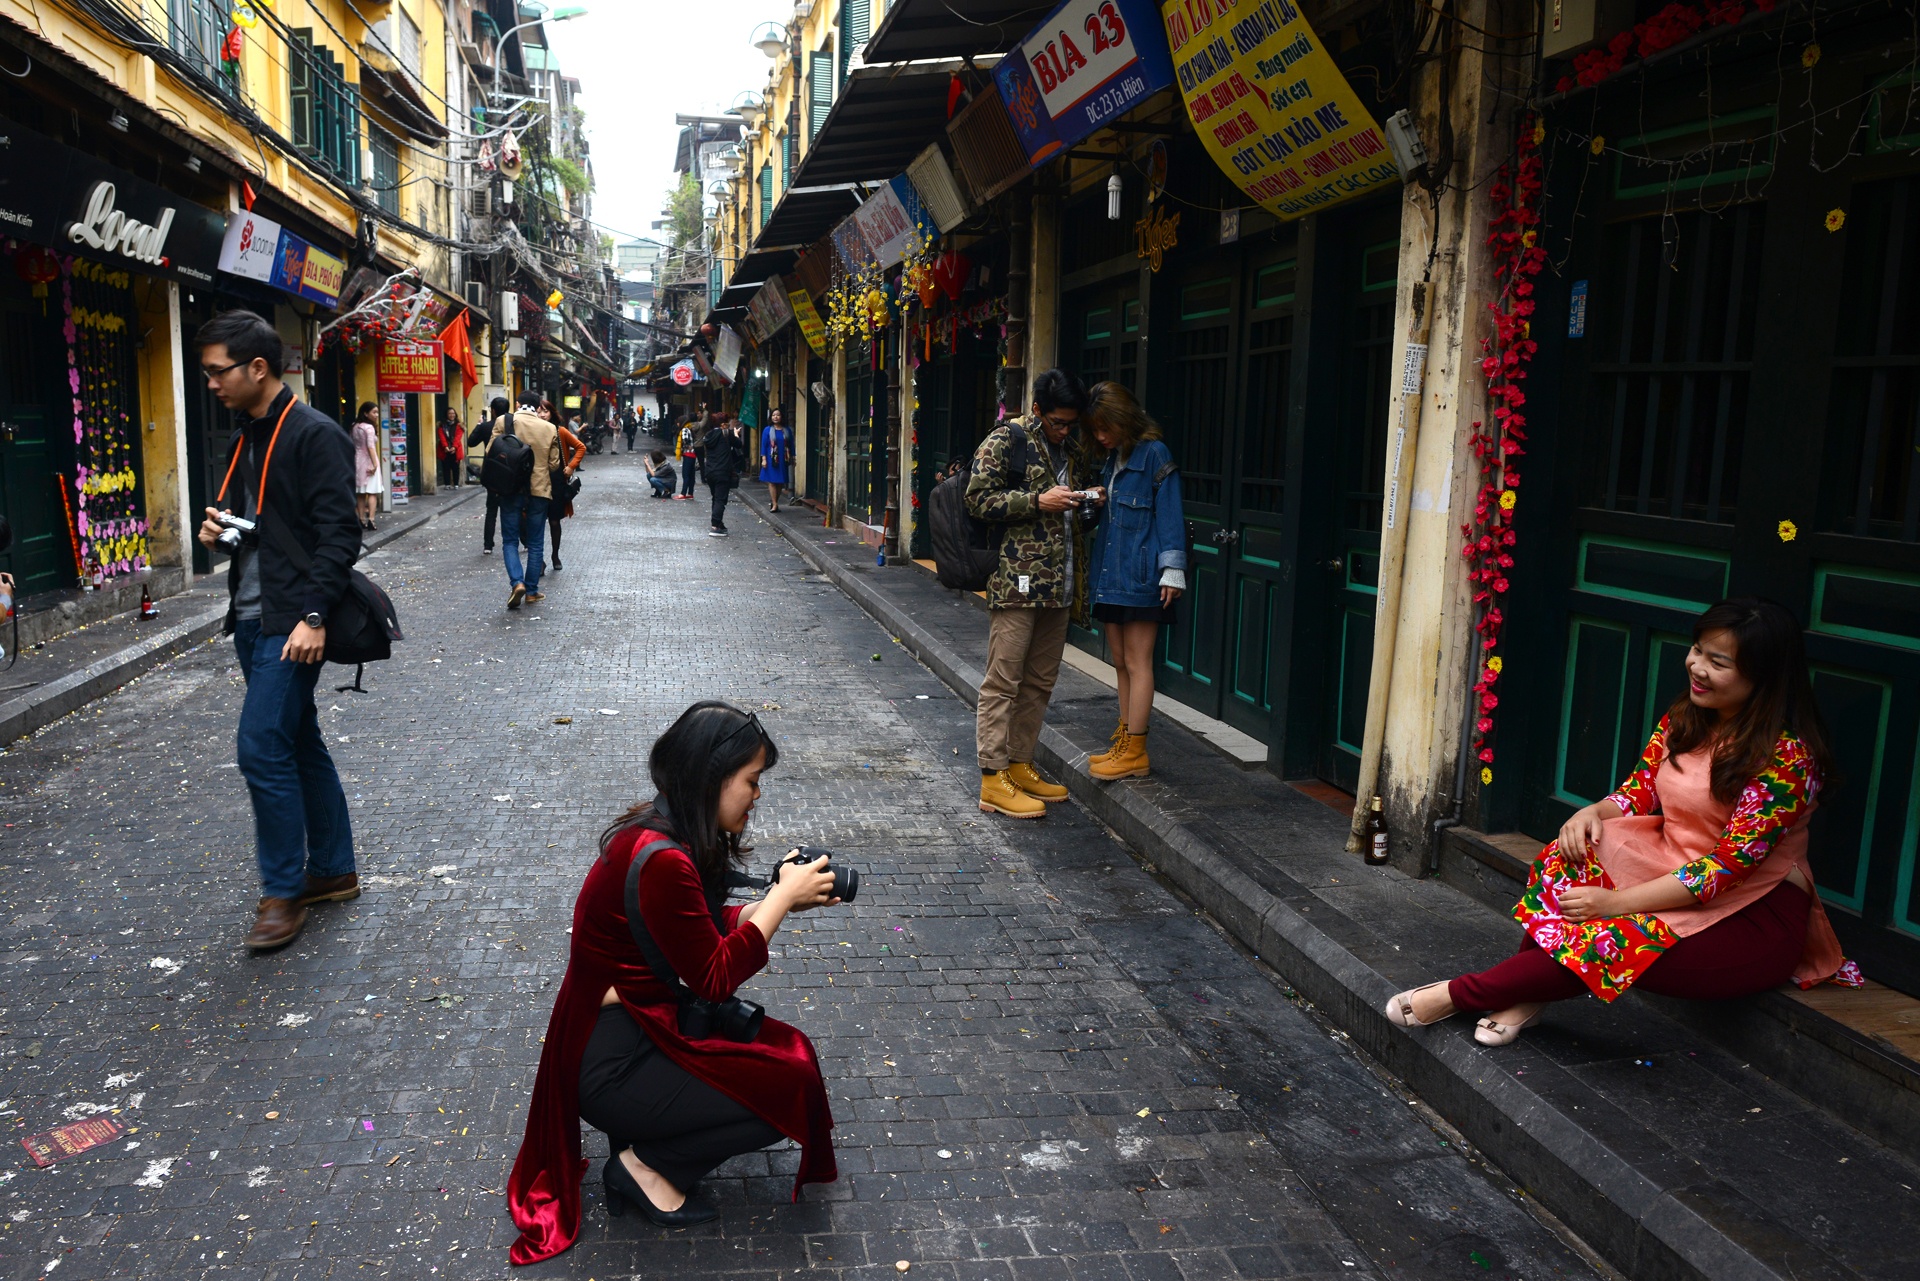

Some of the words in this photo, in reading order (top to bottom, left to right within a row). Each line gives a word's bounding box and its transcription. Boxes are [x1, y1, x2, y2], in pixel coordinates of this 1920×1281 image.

[1030, 30, 1088, 95] BIA
[1084, 0, 1126, 55] 23
[1177, 60, 1198, 94] NEM
[1207, 34, 1234, 71] RÁN
[1255, 53, 1287, 81] Rang
[1280, 31, 1314, 67] muối
[1008, 75, 1039, 130] Tiger
[1085, 102, 1103, 124] ĐC:
[1099, 94, 1114, 115] 23
[1210, 80, 1237, 112] SỤN
[1228, 69, 1252, 99] GÀ
[1289, 77, 1313, 101] cay
[1213, 118, 1246, 148] CÁNH
[1236, 108, 1260, 135] GÀ
[1231, 145, 1259, 175] CÚT
[1256, 131, 1294, 165] LỘN
[1283, 116, 1322, 149] XÀO
[1313, 101, 1350, 134] ME
[1244, 182, 1264, 202] BÒ
[1278, 166, 1306, 194] CAY
[1302, 150, 1332, 178] CHIM
[1327, 139, 1358, 167] CÚT
[1348, 127, 1386, 159] QUAY
[1304, 181, 1341, 208] KHÁT
[1336, 173, 1370, 192] CÁC
[16, 213, 34, 228] Kiếm
[1136, 204, 1181, 273] Tiger
[1222, 213, 1238, 239] 23
[305, 260, 318, 282] BIA
[380, 356, 409, 375] LITTLE
[411, 356, 439, 376] HANOI
